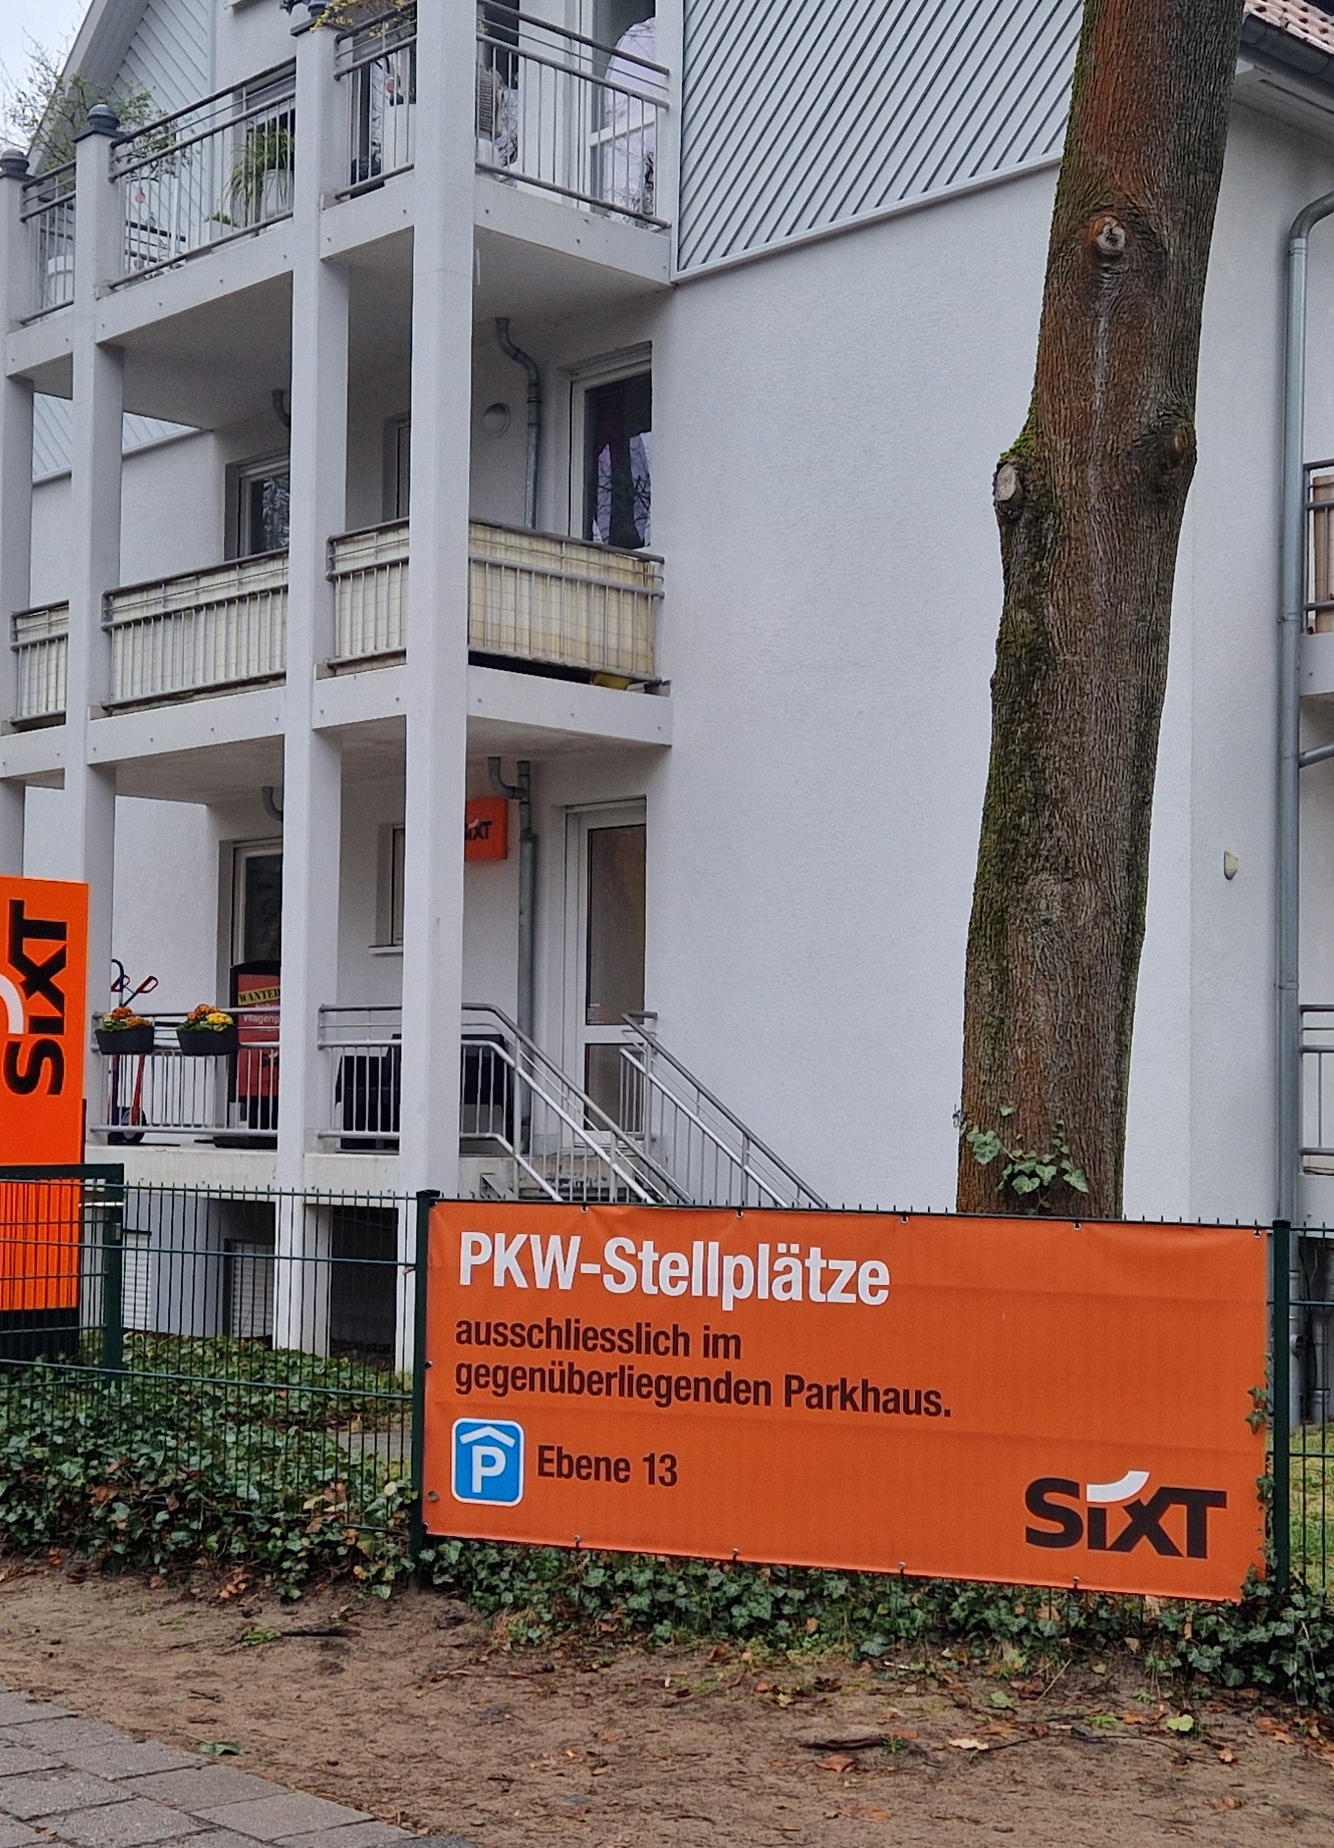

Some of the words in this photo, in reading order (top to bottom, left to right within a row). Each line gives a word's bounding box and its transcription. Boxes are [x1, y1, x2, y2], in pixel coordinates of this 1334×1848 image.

[458, 1230, 891, 1311] PKW-Stellplätze
[454, 1316, 691, 1358] ausschliesslich
[702, 1325, 743, 1360] im
[454, 1359, 772, 1408] gegenüberliegenden
[783, 1373, 953, 1418] Parkhaus.
[471, 1445, 507, 1494] P
[537, 1444, 632, 1484] Ebene
[642, 1452, 678, 1487] 13
[1024, 1470, 1228, 1560] SIXT
